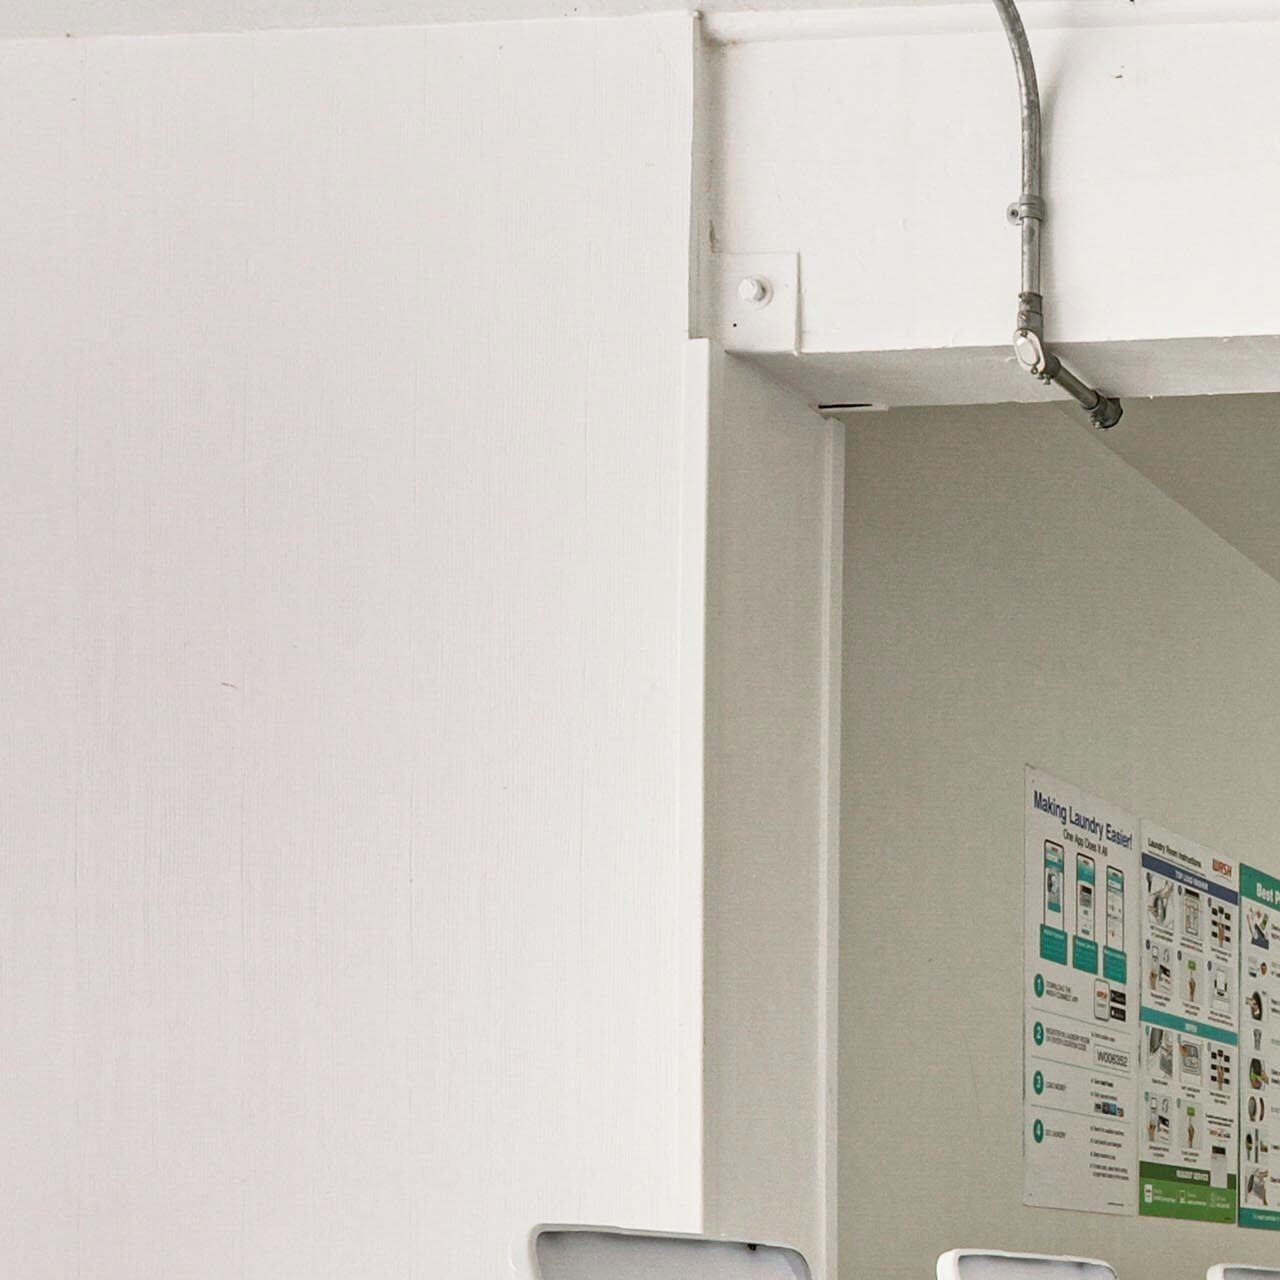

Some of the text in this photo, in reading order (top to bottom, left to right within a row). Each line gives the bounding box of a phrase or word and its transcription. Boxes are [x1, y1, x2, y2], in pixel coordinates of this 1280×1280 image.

[1033, 789, 1132, 850] Making Laundry Easier!
[1063, 828, 1073, 842] One
[1075, 834, 1084, 848] App
[1256, 882, 1274, 903] Best
